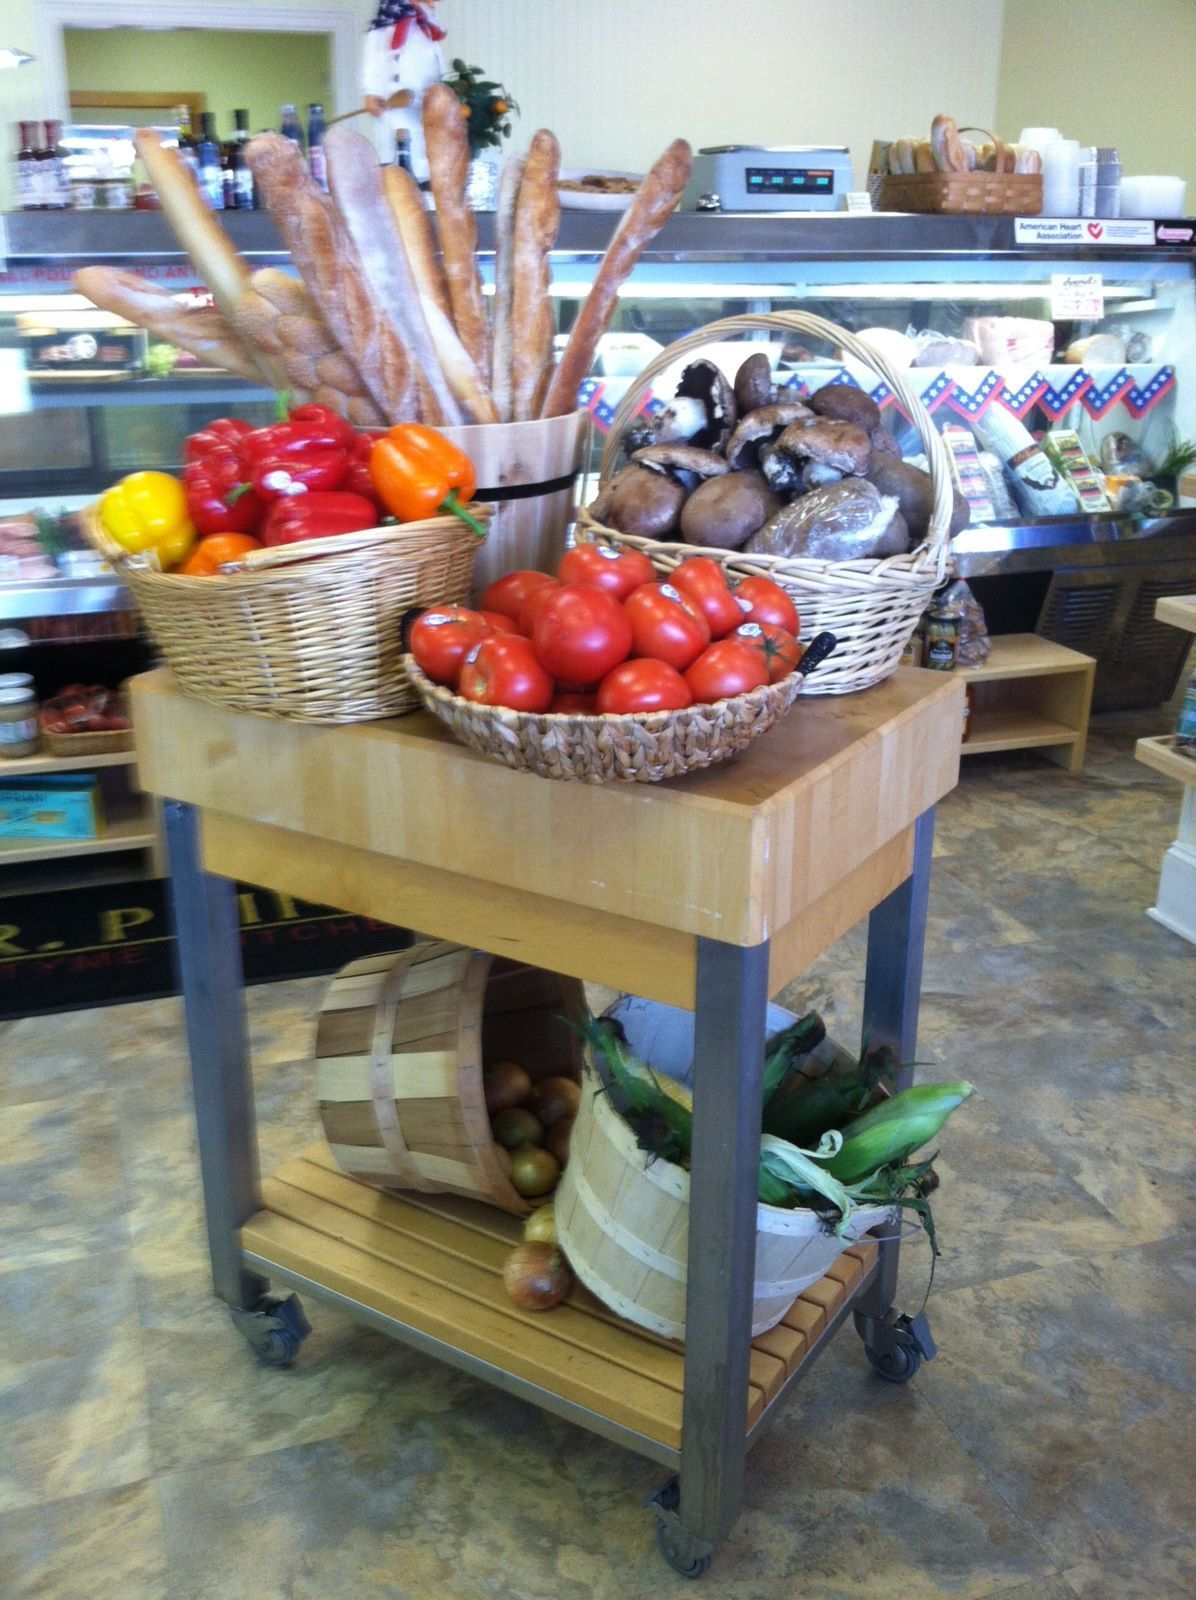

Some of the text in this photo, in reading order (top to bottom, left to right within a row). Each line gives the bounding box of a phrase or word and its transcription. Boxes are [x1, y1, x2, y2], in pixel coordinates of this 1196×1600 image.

[1019, 222, 1082, 231] American Heart
[1036, 231, 1083, 240] Association
